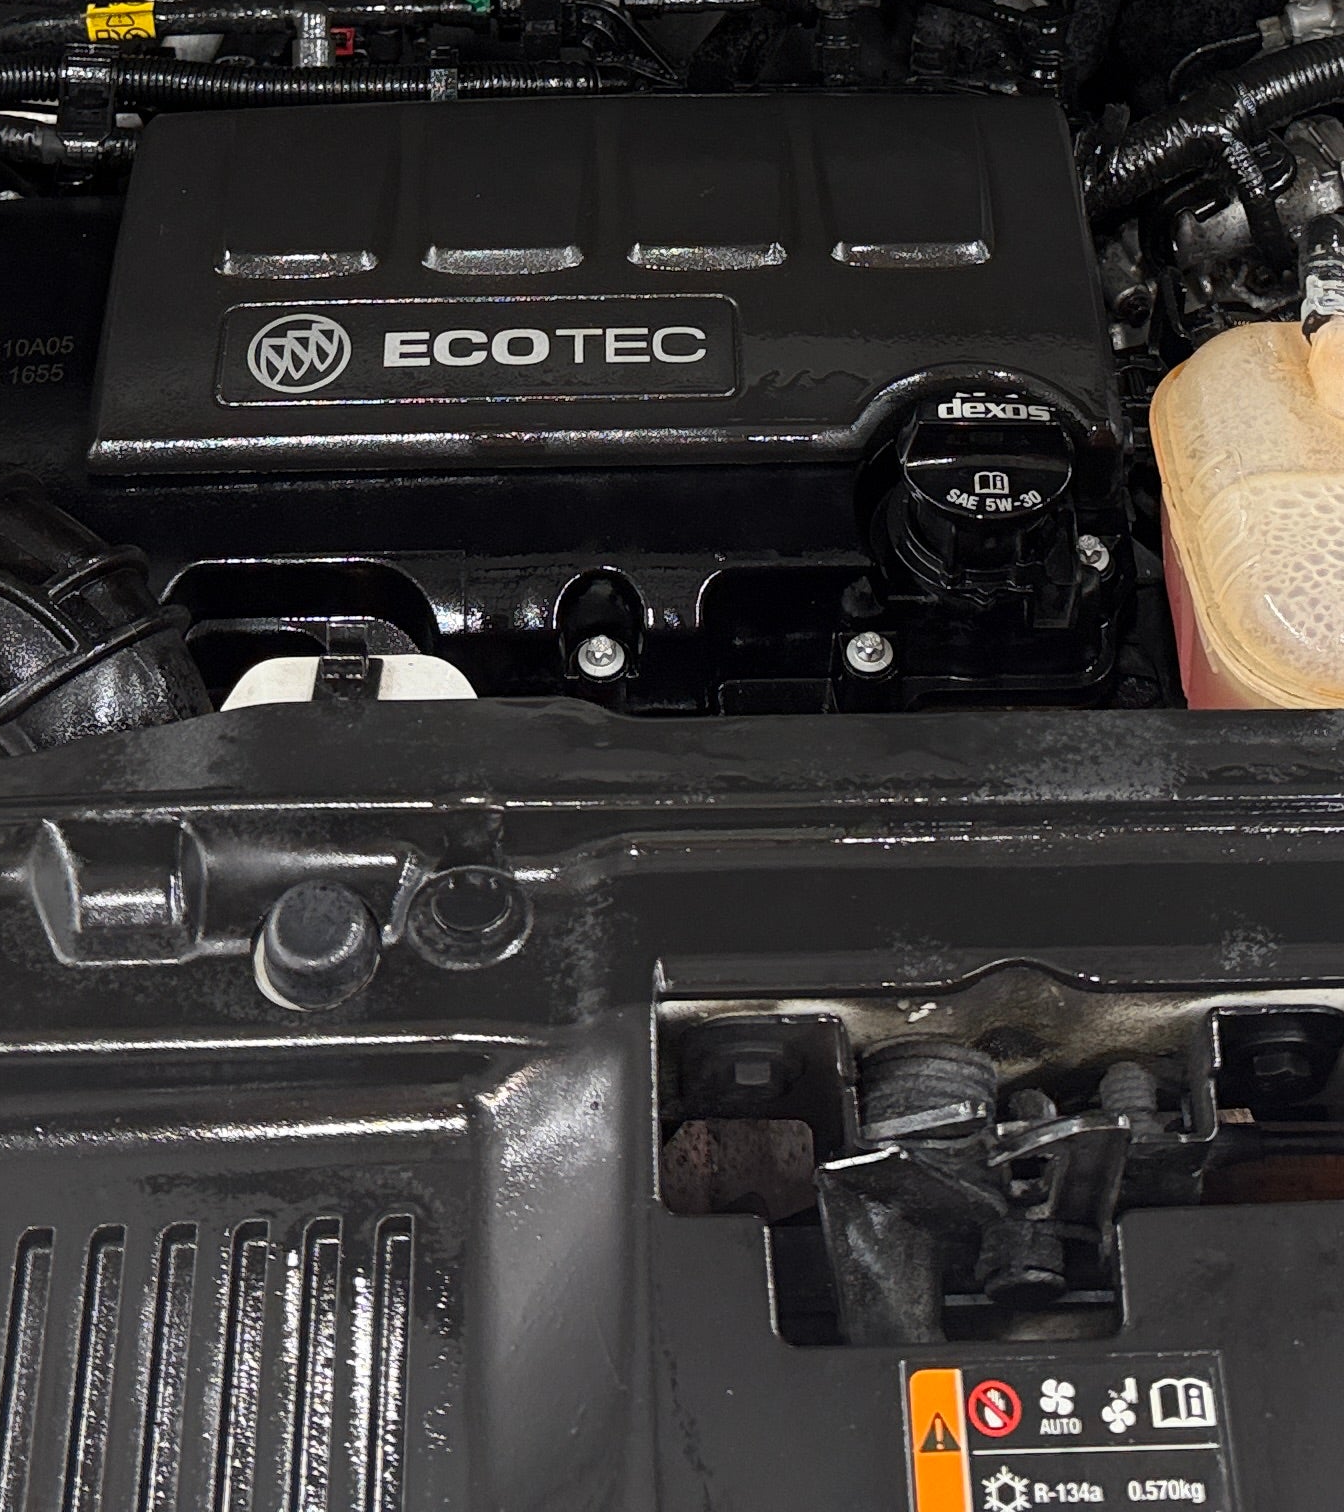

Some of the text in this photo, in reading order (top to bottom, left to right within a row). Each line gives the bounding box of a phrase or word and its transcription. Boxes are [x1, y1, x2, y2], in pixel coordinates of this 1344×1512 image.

[383, 326, 707, 368] ECOTEC
[9, 364, 65, 385] 1655
[937, 398, 1051, 421] dexos
[946, 488, 1042, 512] SAE 5W-30
[1040, 1417, 1083, 1436] AUTO
[1034, 1478, 1206, 1504] R-134a 0.570kg
